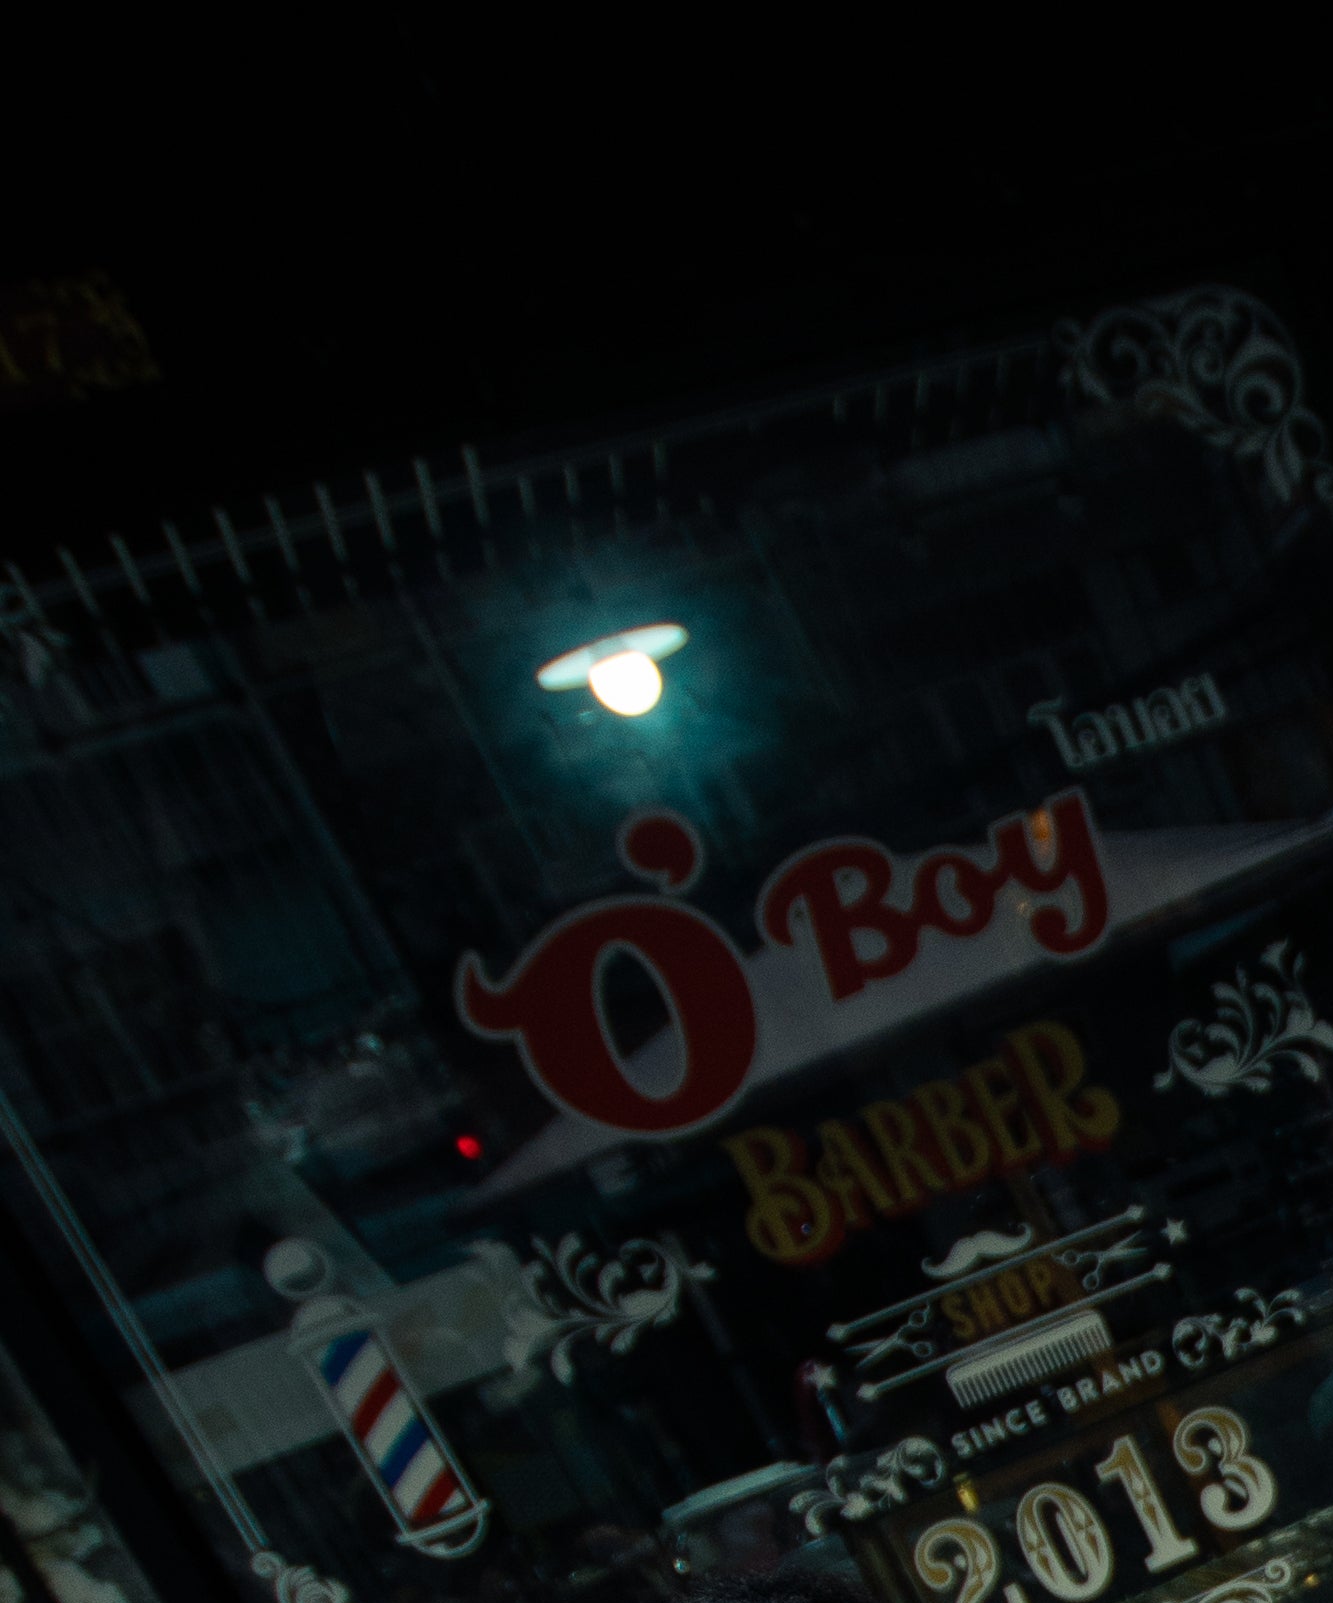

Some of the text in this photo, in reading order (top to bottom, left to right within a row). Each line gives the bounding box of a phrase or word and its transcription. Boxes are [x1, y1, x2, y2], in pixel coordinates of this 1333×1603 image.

[1027, 670, 1227, 772] โอบอย
[718, 1018, 1123, 1269] BARBER
[940, 1258, 1057, 1341] SHOP
[950, 1349, 1166, 1459] SINCE BRAND
